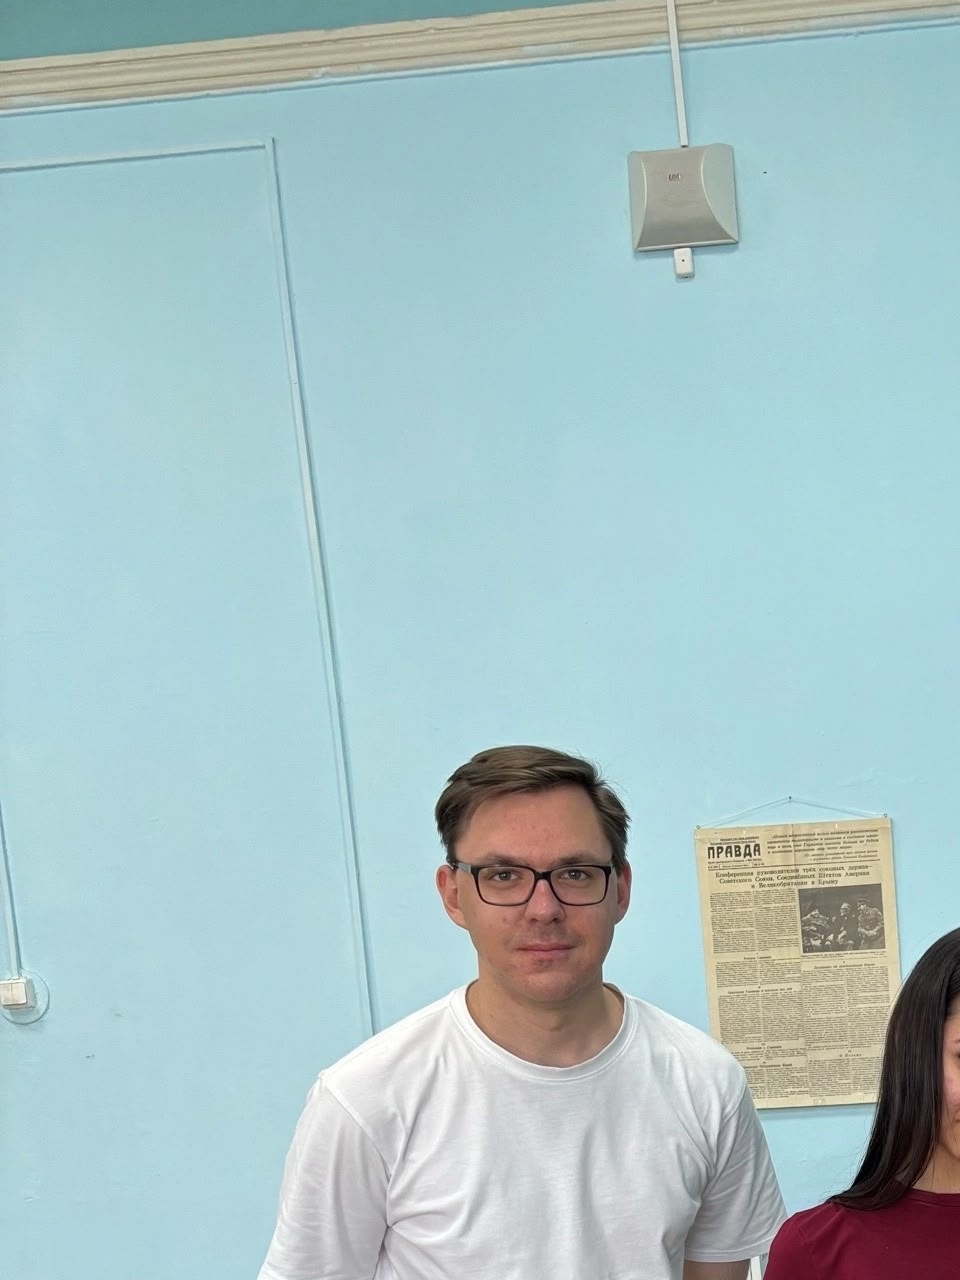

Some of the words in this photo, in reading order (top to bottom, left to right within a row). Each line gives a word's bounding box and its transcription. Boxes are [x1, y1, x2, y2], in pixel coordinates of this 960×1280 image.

[707, 843, 761, 859] ПРАВДА
[819, 871, 842, 879] Штатов
[845, 870, 871, 878] Америки
[818, 878, 839, 886] Крыму
